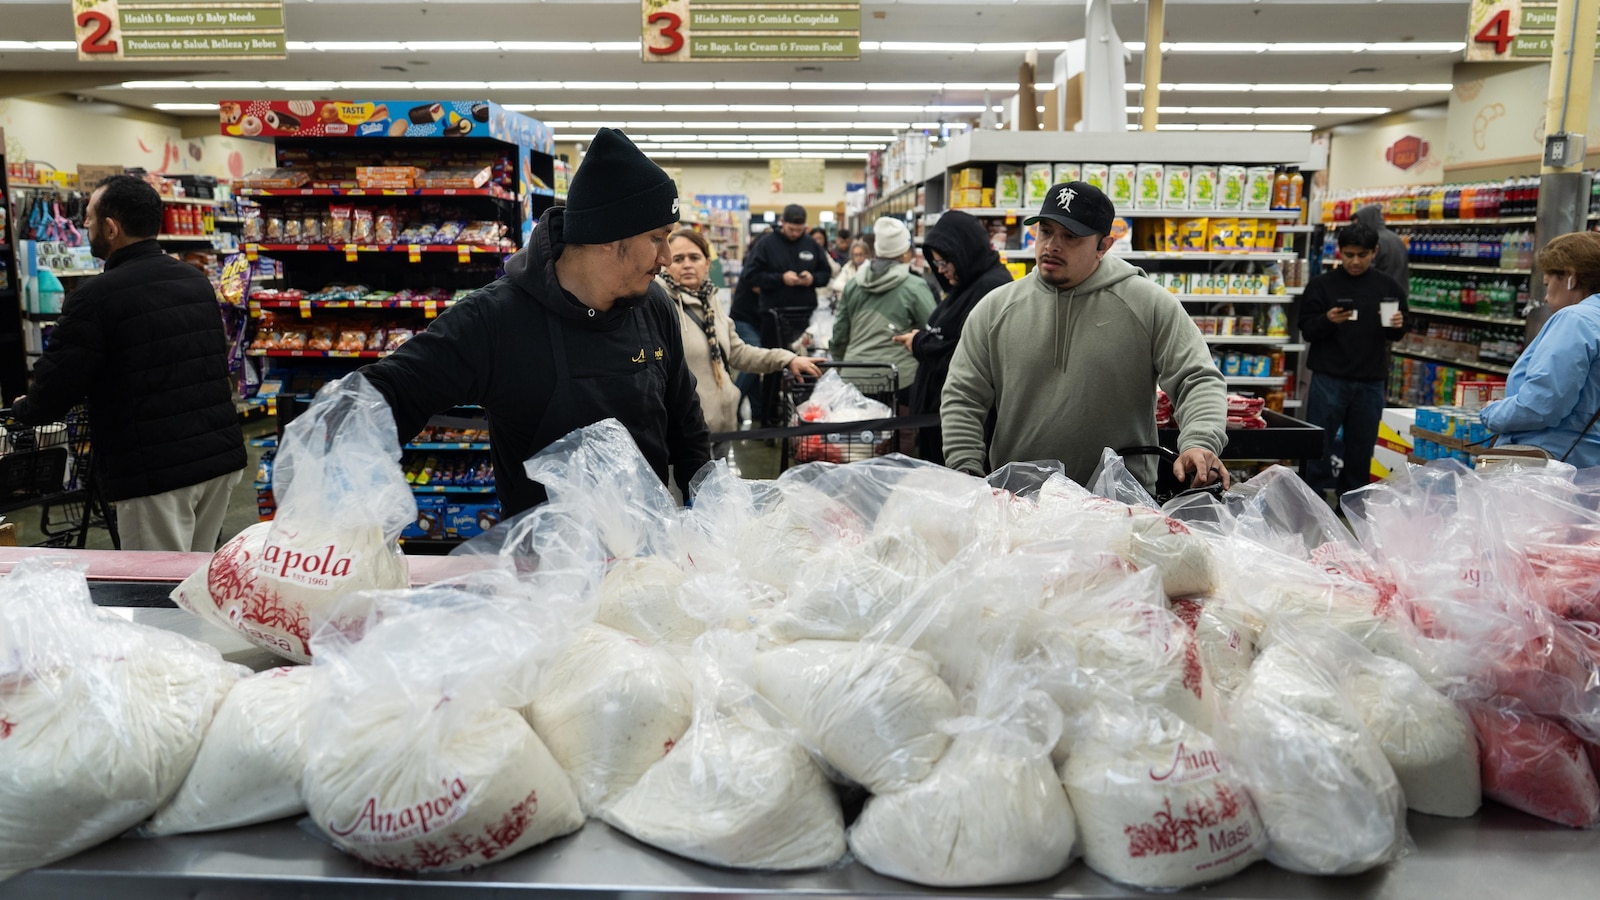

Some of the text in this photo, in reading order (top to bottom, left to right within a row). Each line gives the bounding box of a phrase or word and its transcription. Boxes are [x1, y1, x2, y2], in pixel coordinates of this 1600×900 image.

[124, 12, 256, 25] Health & Beauty & Baby Needs
[694, 13, 839, 26] Hielo Nieve & Comida Congelada
[1526, 12, 1556, 24] Papita
[77, 11, 117, 53] 2
[648, 12, 684, 54] 3
[1474, 9, 1514, 54] 4
[128, 38, 277, 50] Productos de Salud, Belleza y Bebes
[694, 42, 708, 51] Ice
[734, 42, 748, 51] Ice
[750, 42, 779, 51] Cream
[780, 42, 788, 51] &
[790, 42, 820, 51] Frozen
[822, 41, 843, 51] Food
[1517, 40, 1538, 49] Beer
[1540, 40, 1548, 49] &
[341, 106, 365, 114] TASTE
[264, 545, 353, 578] apola
[308, 577, 329, 586] 1961
